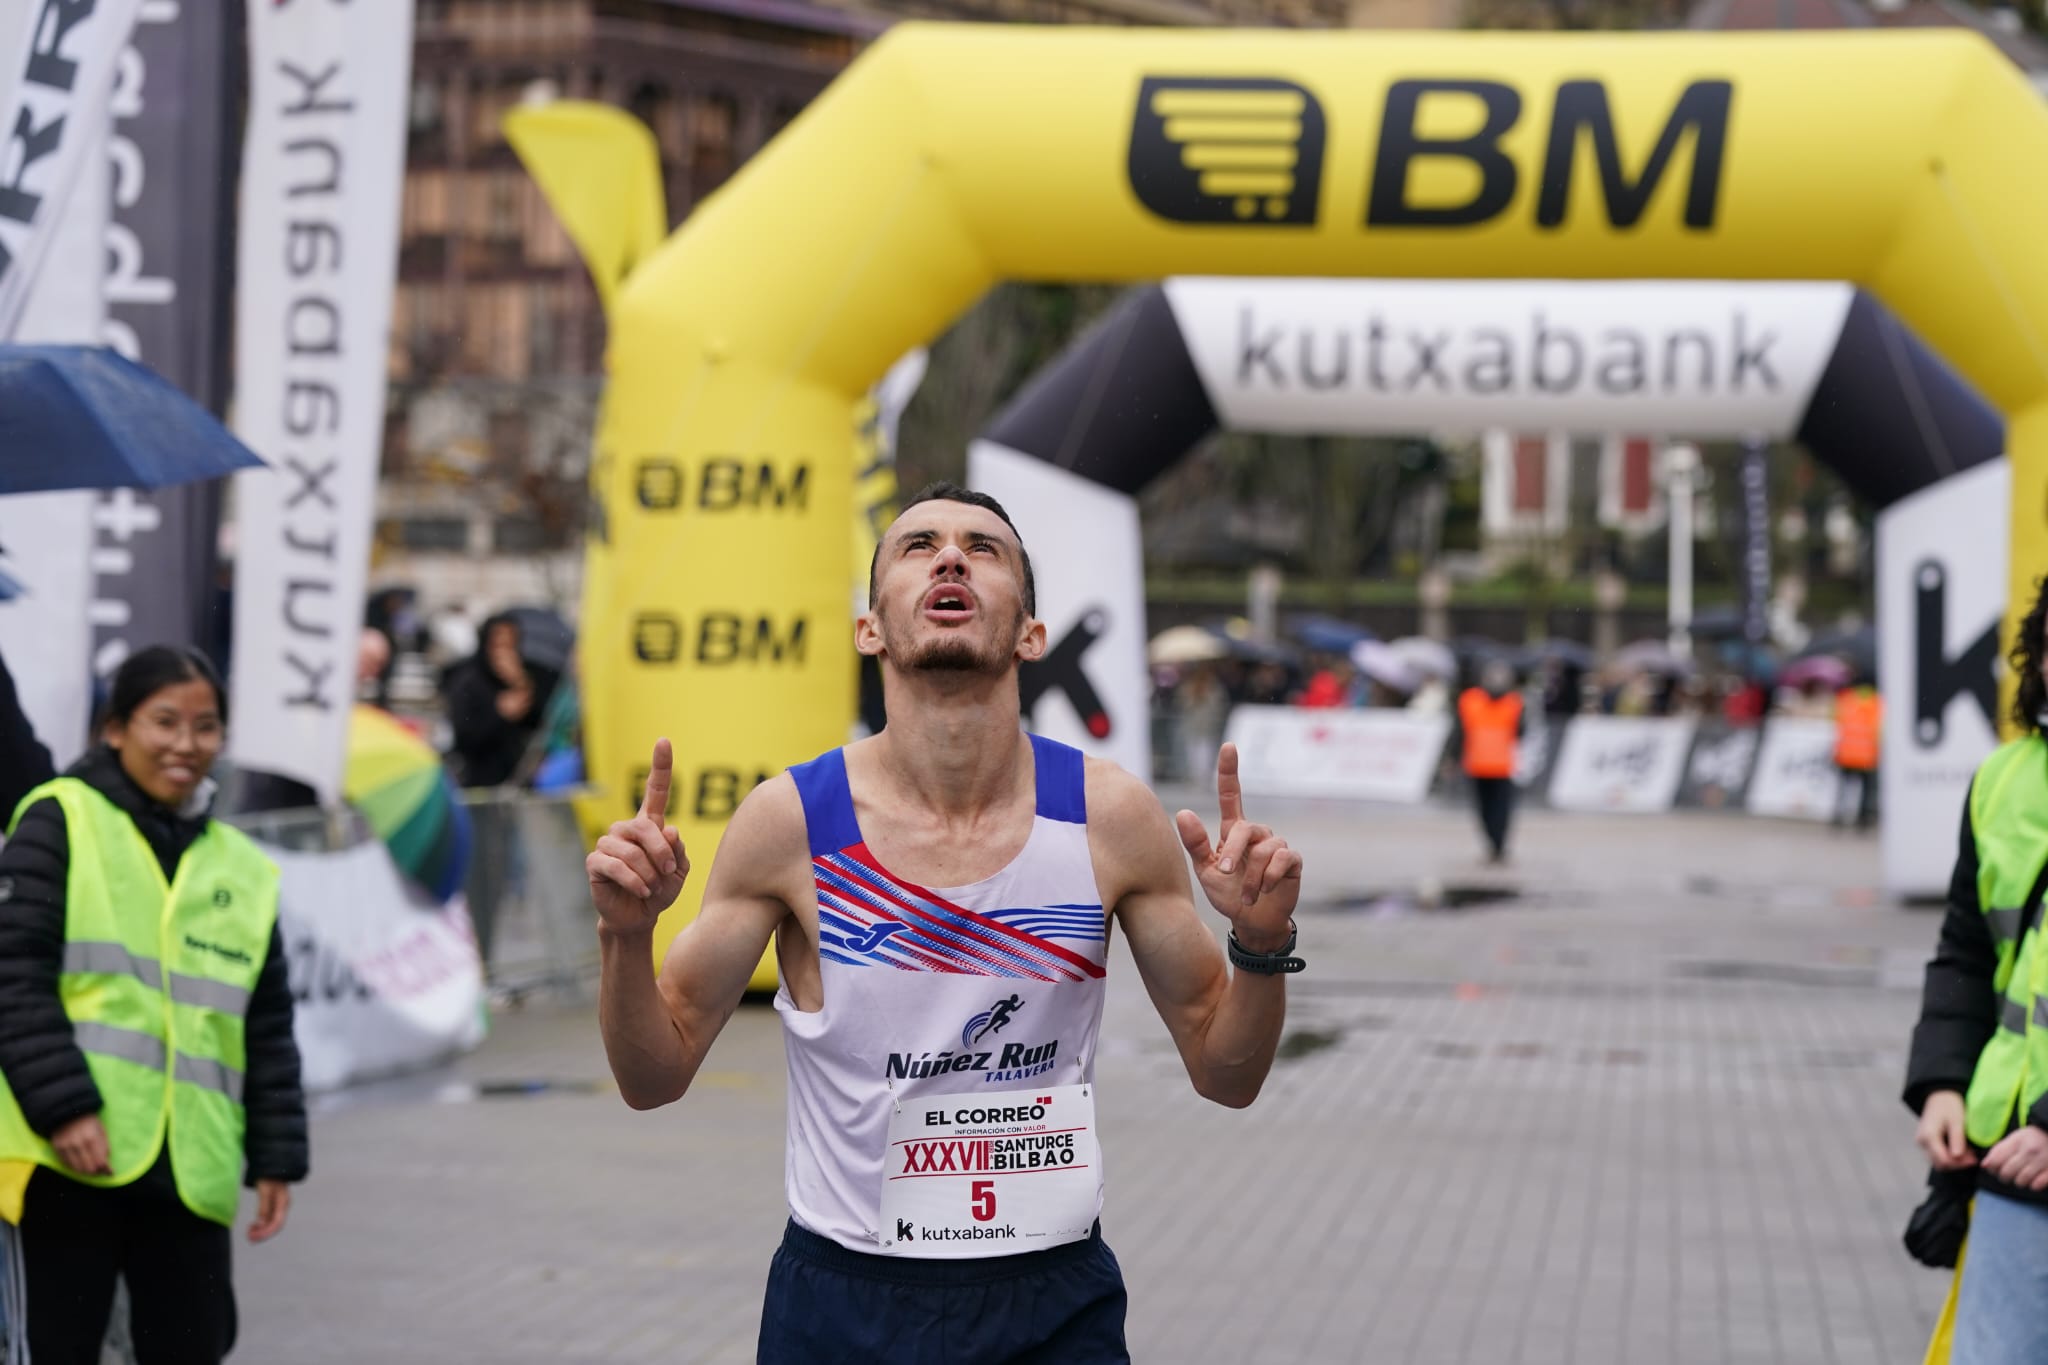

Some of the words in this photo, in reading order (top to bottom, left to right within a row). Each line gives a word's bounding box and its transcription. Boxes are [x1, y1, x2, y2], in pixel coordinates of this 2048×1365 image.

[1364, 78, 1734, 230] BM
[1237, 306, 1782, 396] kutxabank
[700, 458, 811, 511] BM
[697, 612, 808, 665] BM
[885, 1050, 993, 1080] Núñez
[998, 1039, 1059, 1070] Run
[985, 1060, 1056, 1082] TALAVERA
[925, 1111, 952, 1126] EL
[955, 1104, 1046, 1125] CORREO
[954, 1127, 1006, 1135] INFORMACIÓN
[1023, 1124, 1047, 1132] VALOR
[902, 1140, 990, 1174] XXXVII
[994, 1133, 1075, 1153] SANTURCE
[994, 1148, 1075, 1170] BILBAO
[971, 1180, 997, 1222] 5
[921, 1223, 1017, 1241] kutxabank
